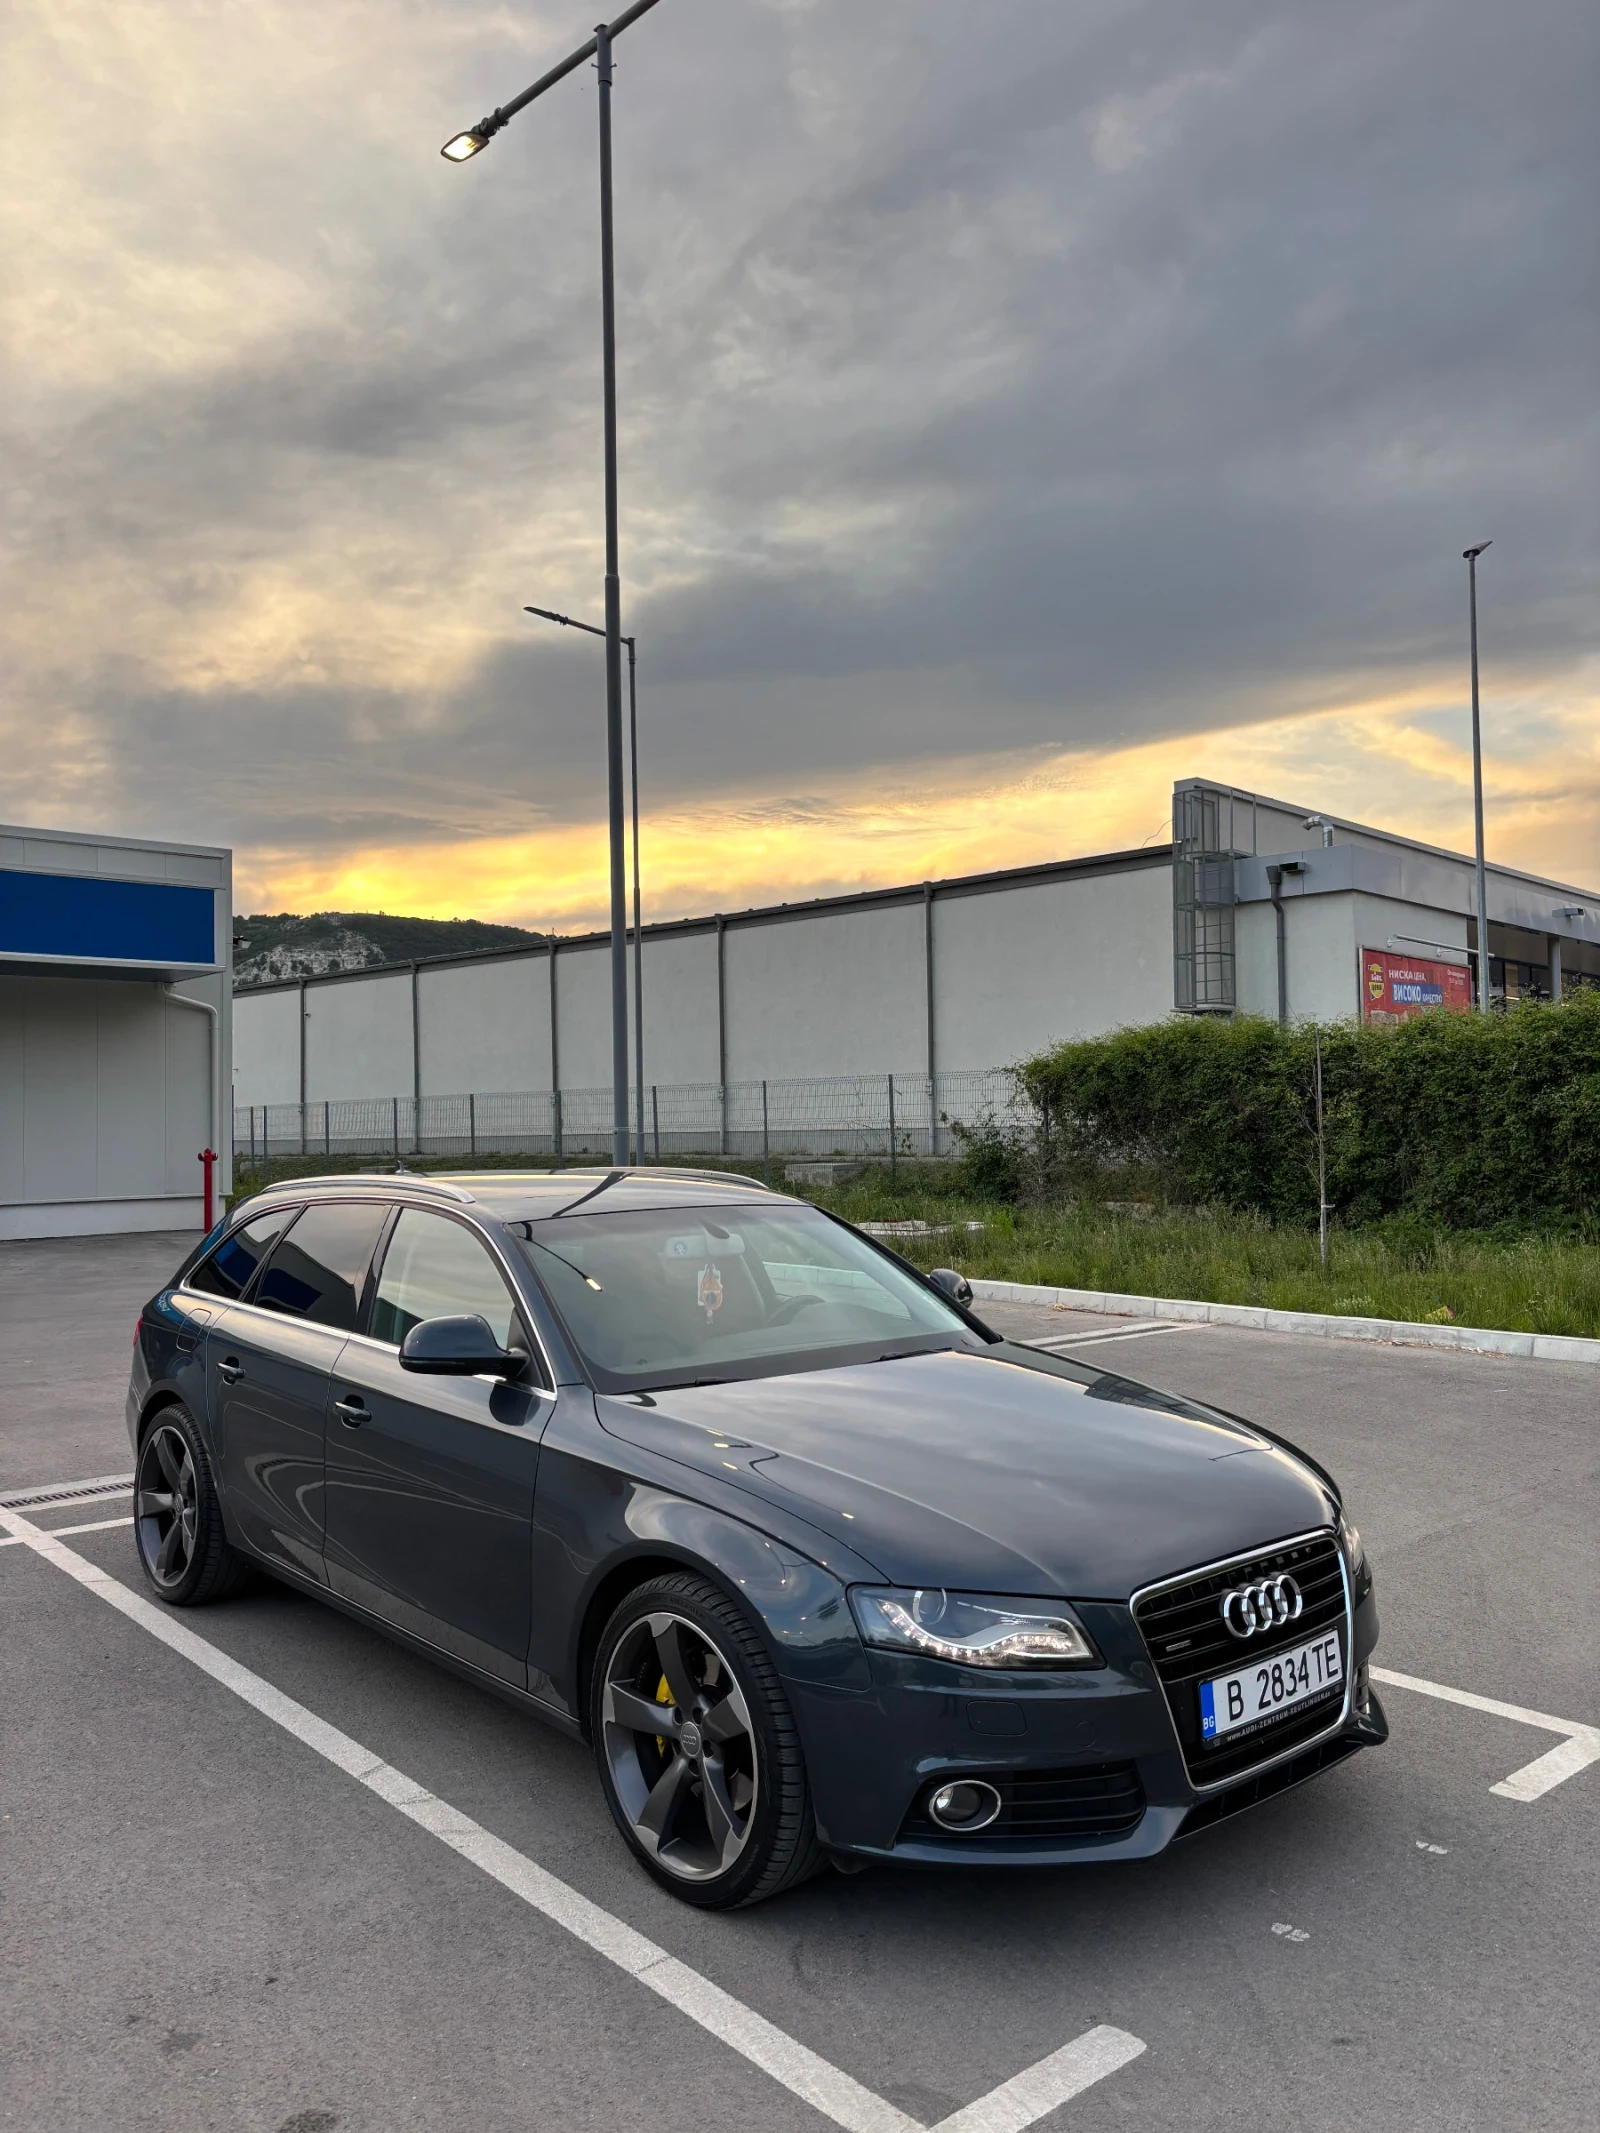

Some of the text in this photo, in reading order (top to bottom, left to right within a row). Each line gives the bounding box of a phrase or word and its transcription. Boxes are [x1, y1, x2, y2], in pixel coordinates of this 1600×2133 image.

[1388, 969, 1414, 980] НИСКА
[1392, 984, 1422, 1002] ВИСОКО
[1227, 1638, 1339, 1722] B 2834 TE
[1203, 1715, 1216, 1731] BG
[1226, 1691, 1331, 1742] www.AUDI-ZENTRUM-REUTLINGEN.de
